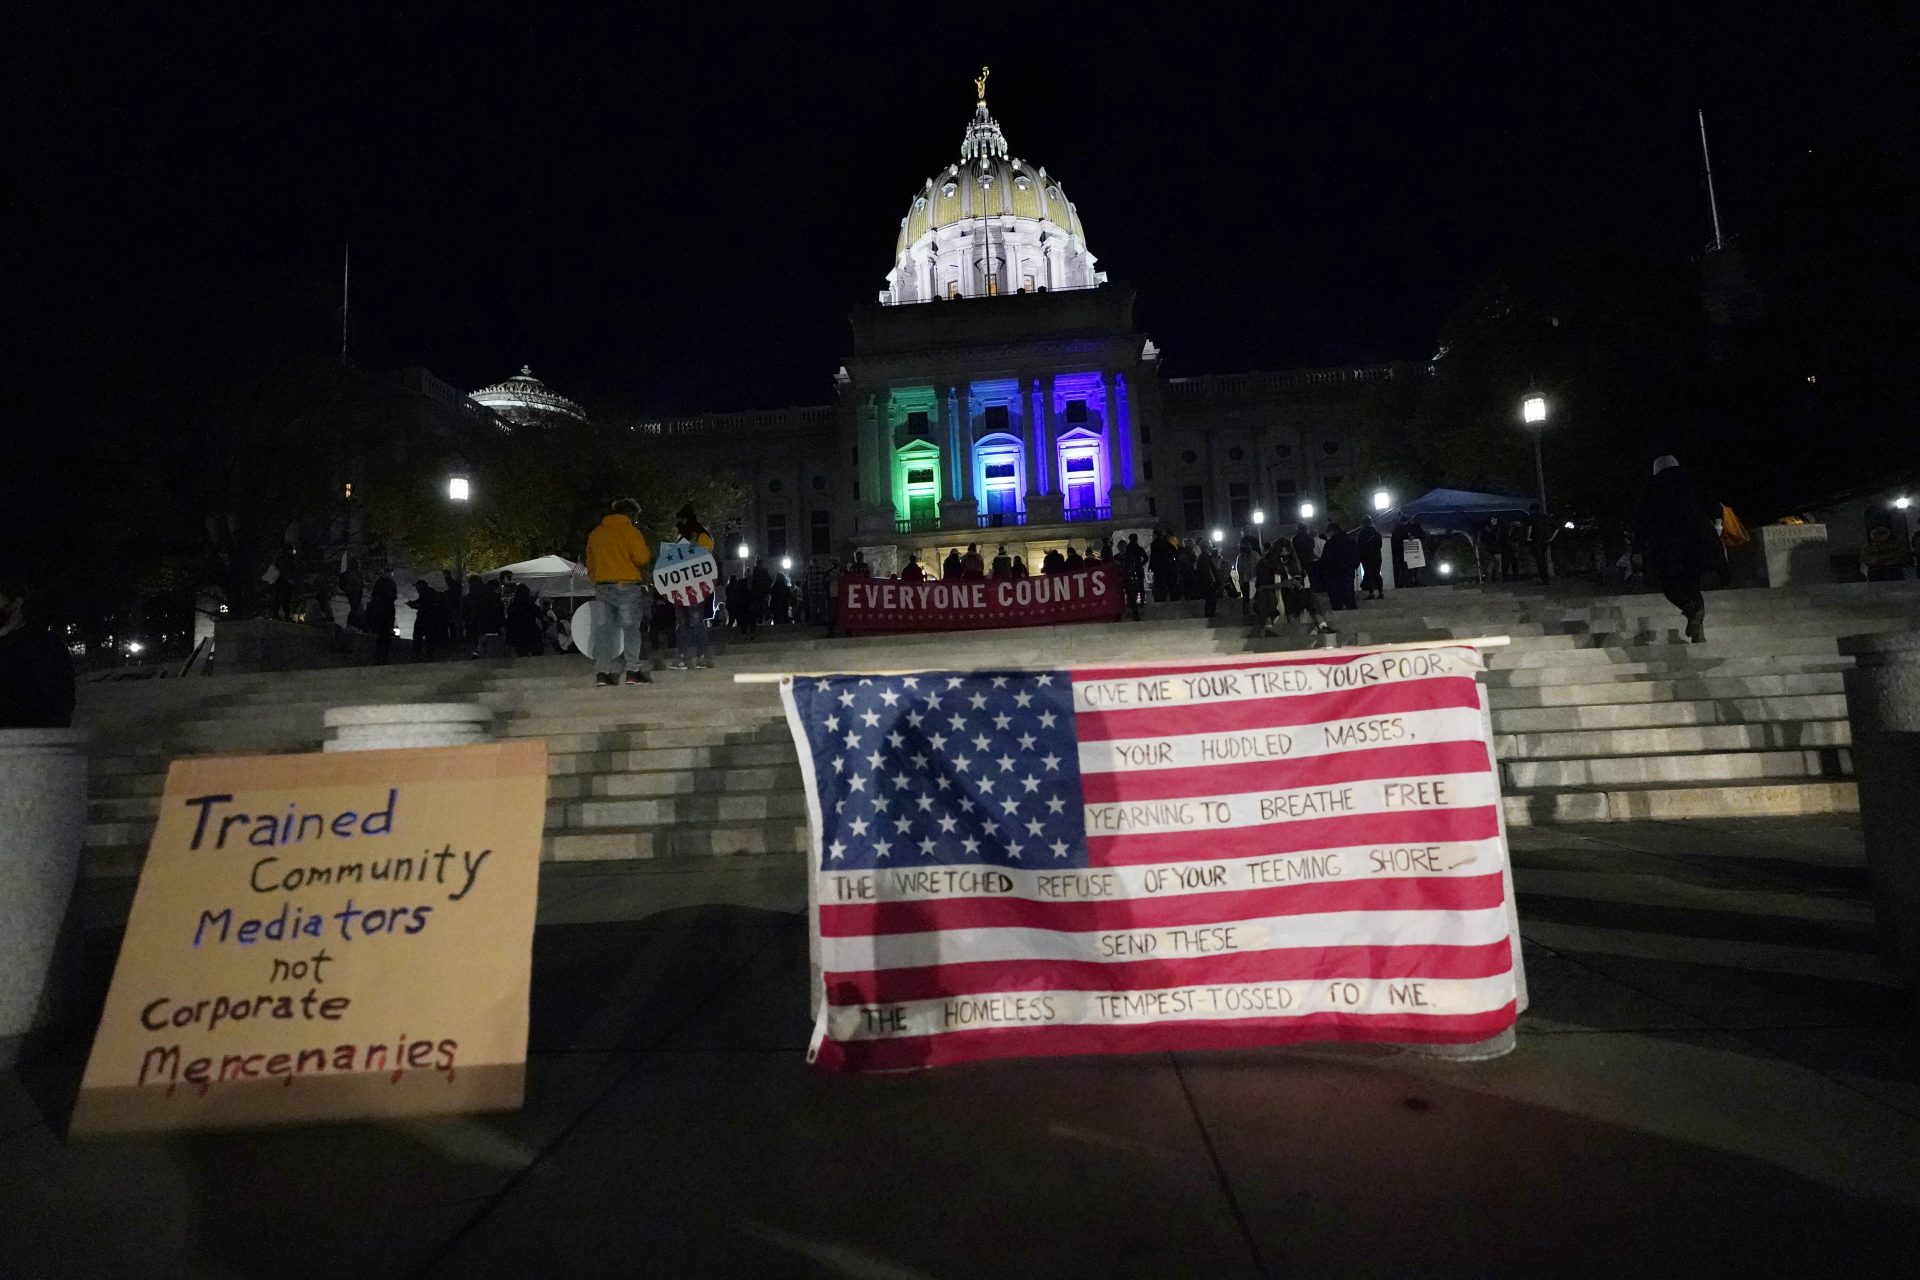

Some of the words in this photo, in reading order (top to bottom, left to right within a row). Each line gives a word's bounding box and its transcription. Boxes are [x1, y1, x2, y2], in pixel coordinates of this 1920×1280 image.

[658, 561, 713, 587] VOTED
[676, 547, 683, 560] I
[848, 583, 987, 610] EVERYONE
[998, 570, 1106, 607] COUNTS
[1084, 682, 1129, 706] GIVE
[1137, 680, 1172, 702] ME
[1182, 675, 1242, 697] YOUR
[1318, 663, 1379, 690] YOUR
[1115, 742, 1174, 766] YOUR
[1201, 733, 1293, 761] HUDDLED
[185, 788, 398, 851] Trained
[1086, 802, 1194, 832] YEARNING
[1201, 801, 1232, 824] TO
[1260, 787, 1353, 821] BREATHE
[1383, 780, 1449, 808] FREE
[250, 843, 492, 901] Community
[831, 875, 877, 900] THE
[895, 871, 1014, 895] WRETCHED
[1037, 874, 1114, 897] REFUSE
[1246, 853, 1343, 884] TEEMING
[193, 900, 434, 948] Mediators
[1101, 934, 1157, 958] SEND
[1167, 926, 1239, 952] THESE
[270, 949, 333, 984] not
[141, 988, 351, 1032] Corporate
[862, 1006, 907, 1033] THE
[943, 997, 1057, 1028] HOMELESS
[1328, 982, 1361, 1005] TO
